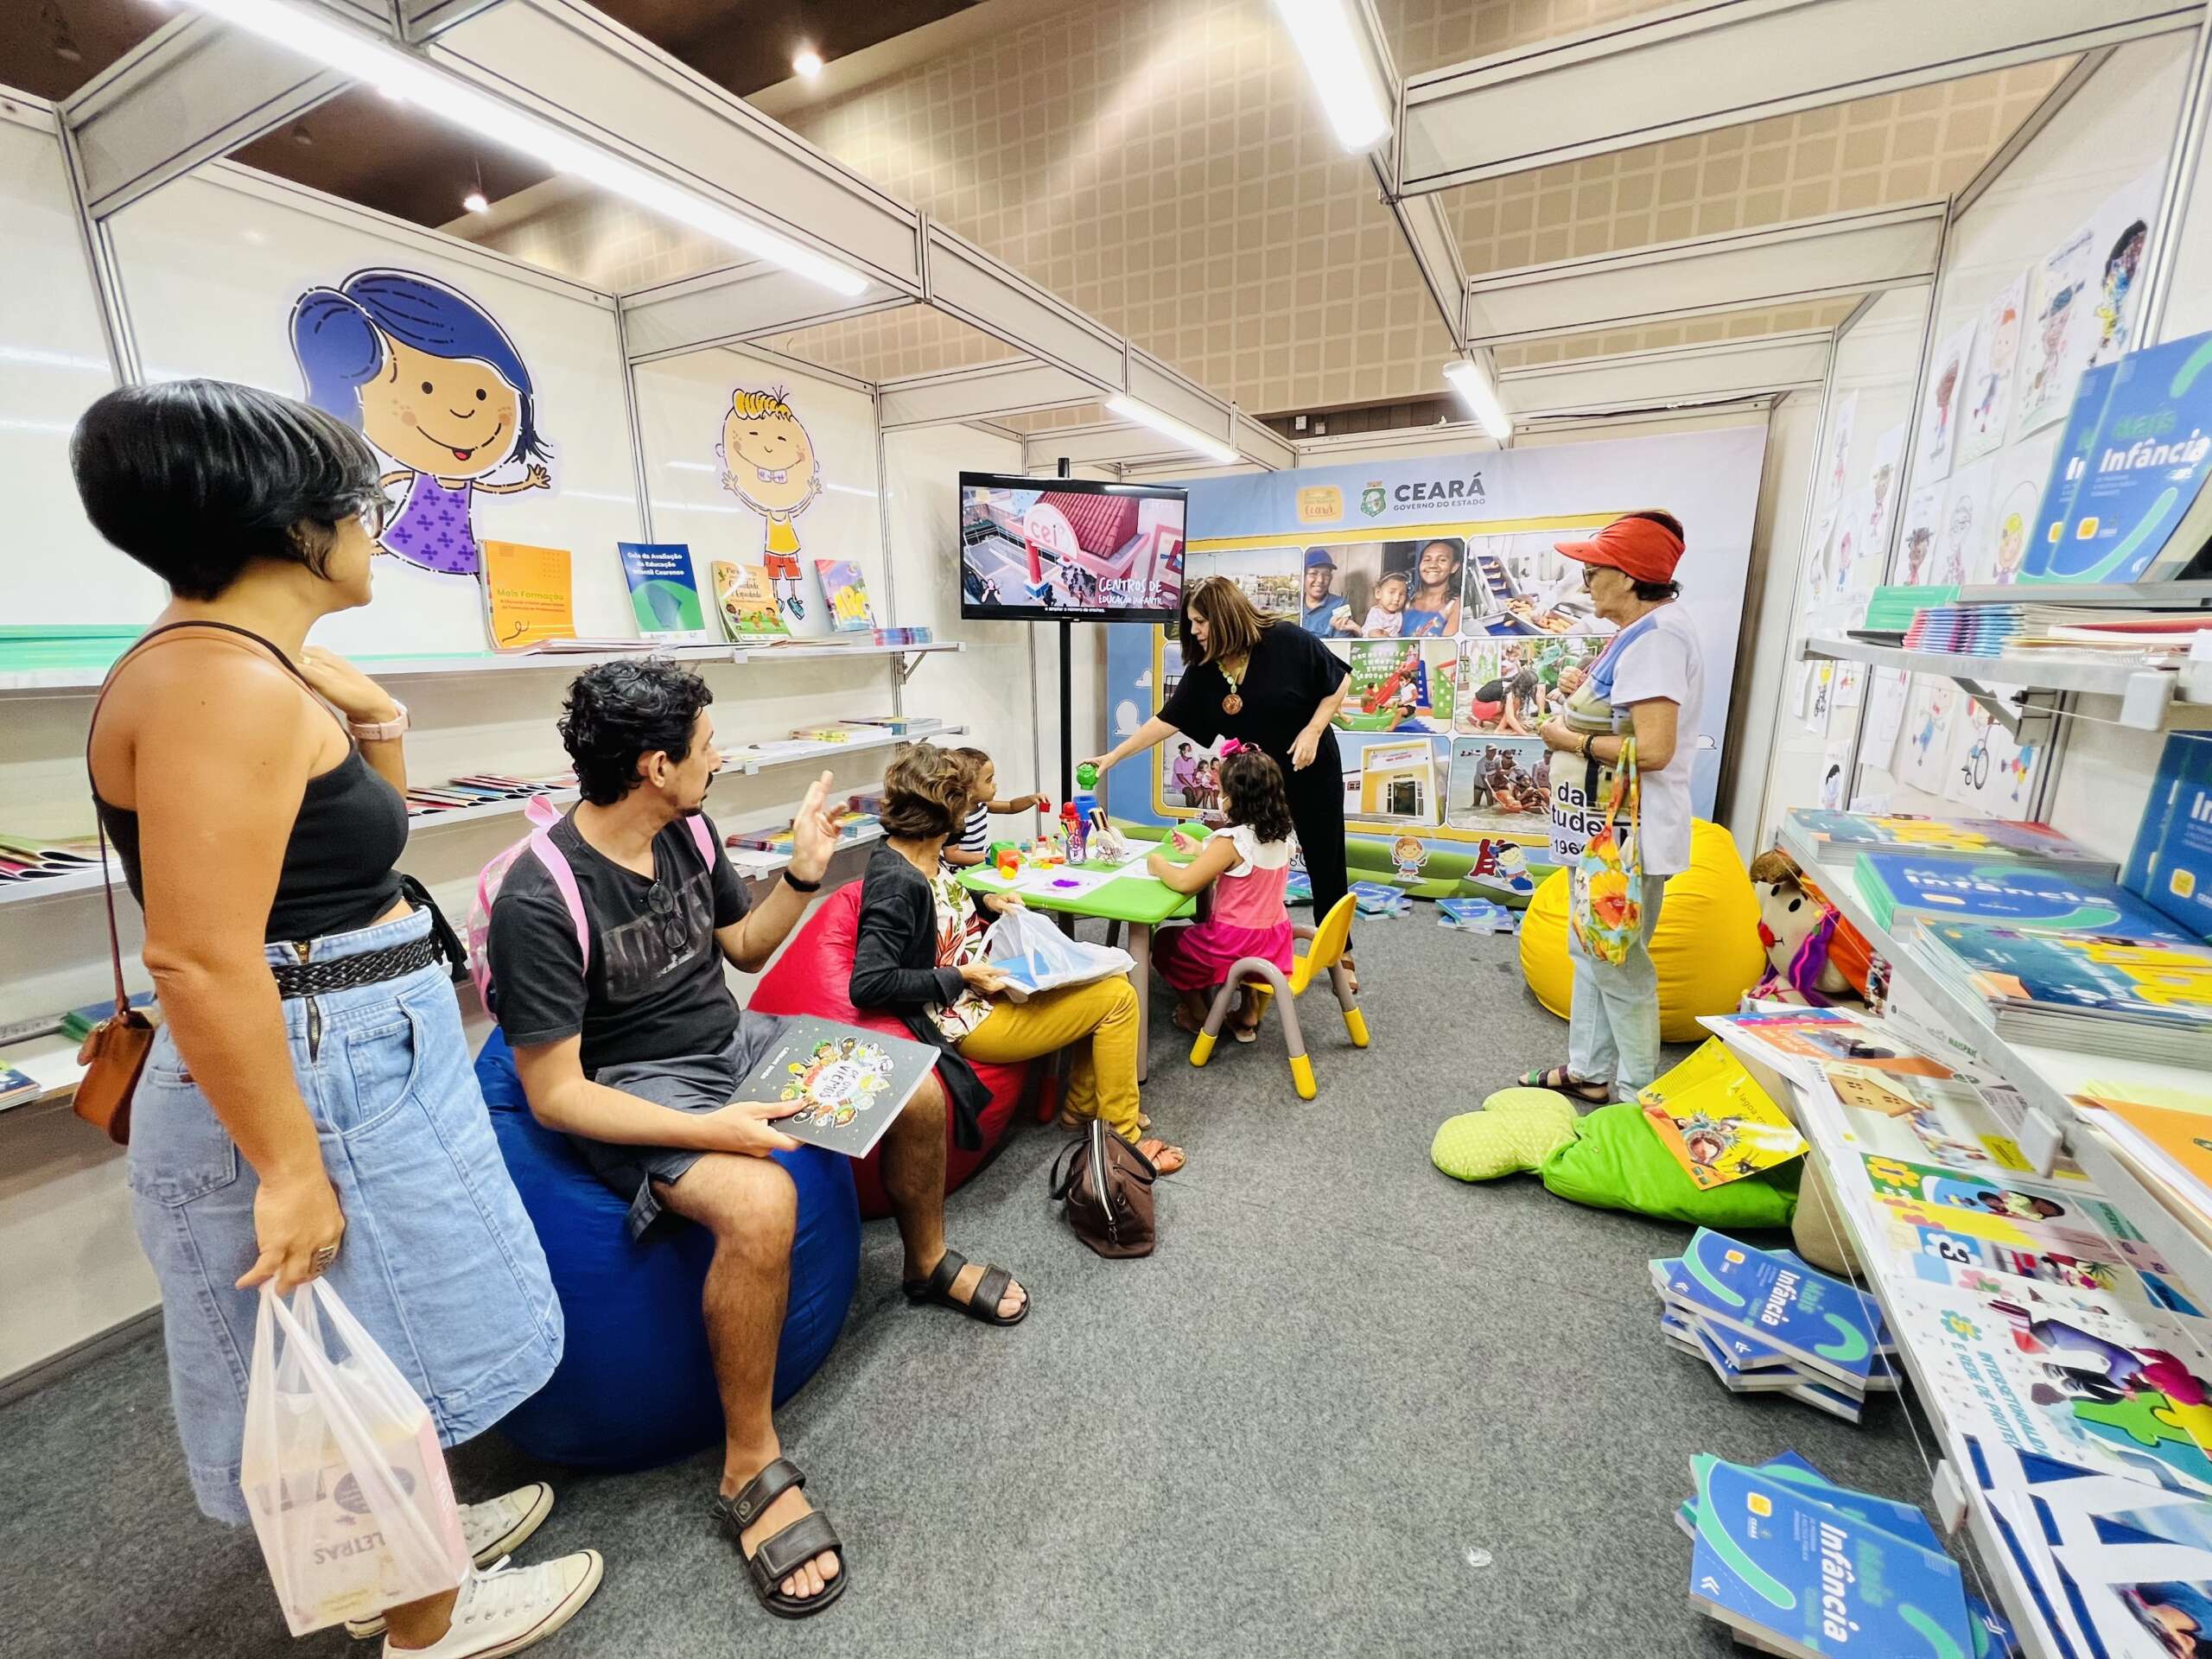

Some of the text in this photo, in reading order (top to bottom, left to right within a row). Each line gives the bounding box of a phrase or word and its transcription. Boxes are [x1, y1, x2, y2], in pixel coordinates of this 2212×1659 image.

[2098, 428, 2211, 474] Infância
[1394, 471, 1485, 502] CEARÁ
[1393, 502, 1434, 511] GOVERNO
[1451, 499, 1485, 507] ESTADO
[1098, 576, 1162, 593] CENTROS DE
[1558, 781, 1586, 808] da
[1738, 1093, 1758, 1116] lagoa
[1761, 1269, 1802, 1326] Infância
[1955, 1352, 1985, 1383] REDE
[1973, 1383, 1996, 1401] DE
[313, 1531, 386, 1566] LETRAS
[1820, 1521, 1860, 1643] Infância
